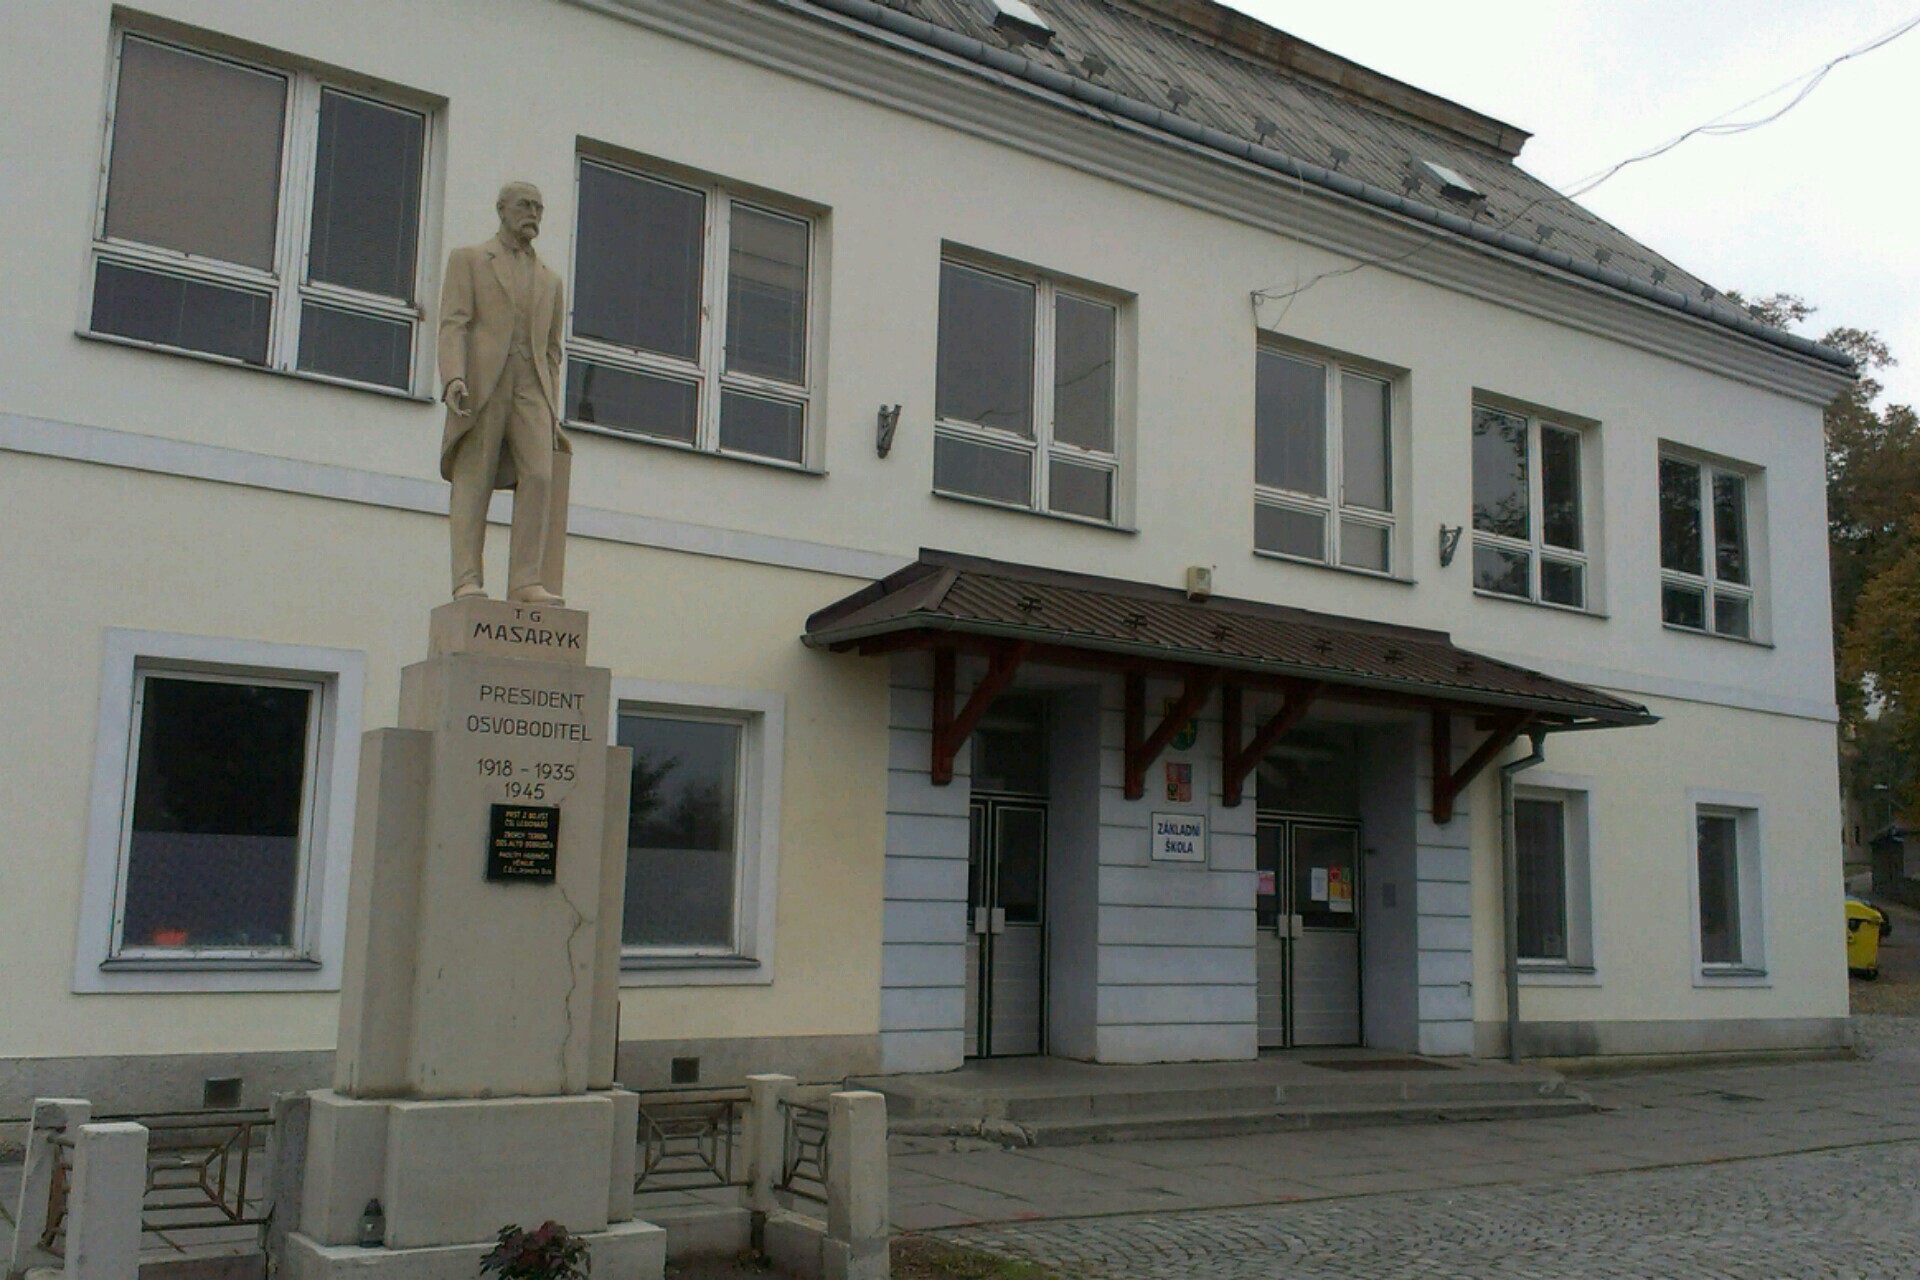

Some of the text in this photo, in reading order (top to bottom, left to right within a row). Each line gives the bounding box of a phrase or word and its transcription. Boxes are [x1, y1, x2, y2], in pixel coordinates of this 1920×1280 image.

[473, 622, 580, 649] MASARYK
[479, 684, 585, 710] PRESIDENT
[467, 715, 592, 742] OSVOBODITEL
[477, 758, 513, 777] 1918
[535, 762, 575, 781] 1935
[504, 782, 545, 801] 1945
[1157, 819, 1201, 837] ZÁKLADNÍ
[1165, 838, 1193, 854] ŠKOLA
